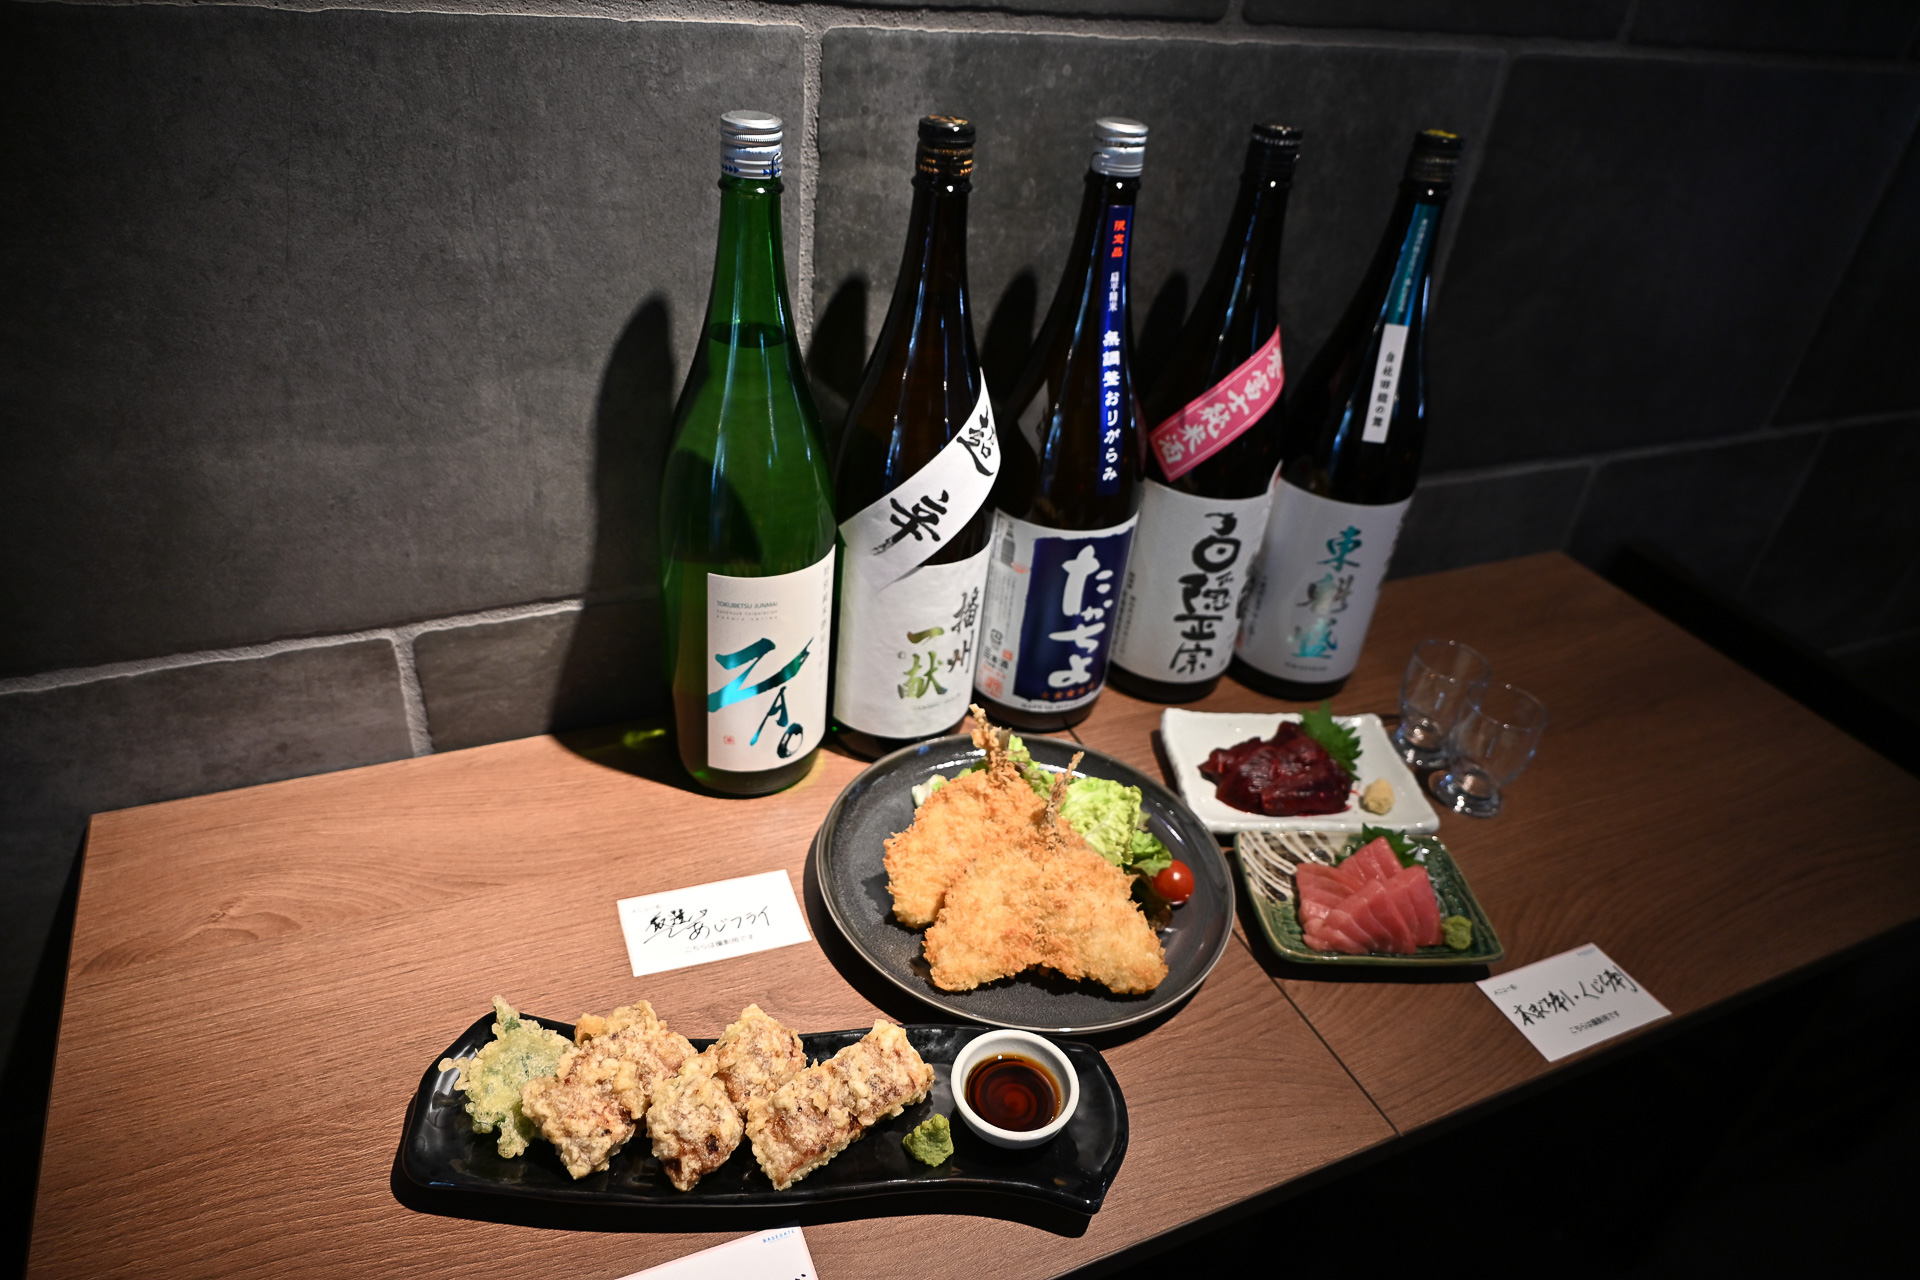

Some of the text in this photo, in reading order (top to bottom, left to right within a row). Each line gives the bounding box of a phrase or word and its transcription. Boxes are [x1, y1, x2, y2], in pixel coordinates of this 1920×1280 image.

[1111, 219, 1126, 258] 限定品
[1102, 330, 1121, 482] 無調整おりがらみ
[947, 586, 980, 674] 播州
[1048, 544, 1115, 688] たかちよ
[707, 637, 815, 759] ZAO
[897, 626, 948, 700] 一献
[762, 1229, 796, 1243] BASEGATE
